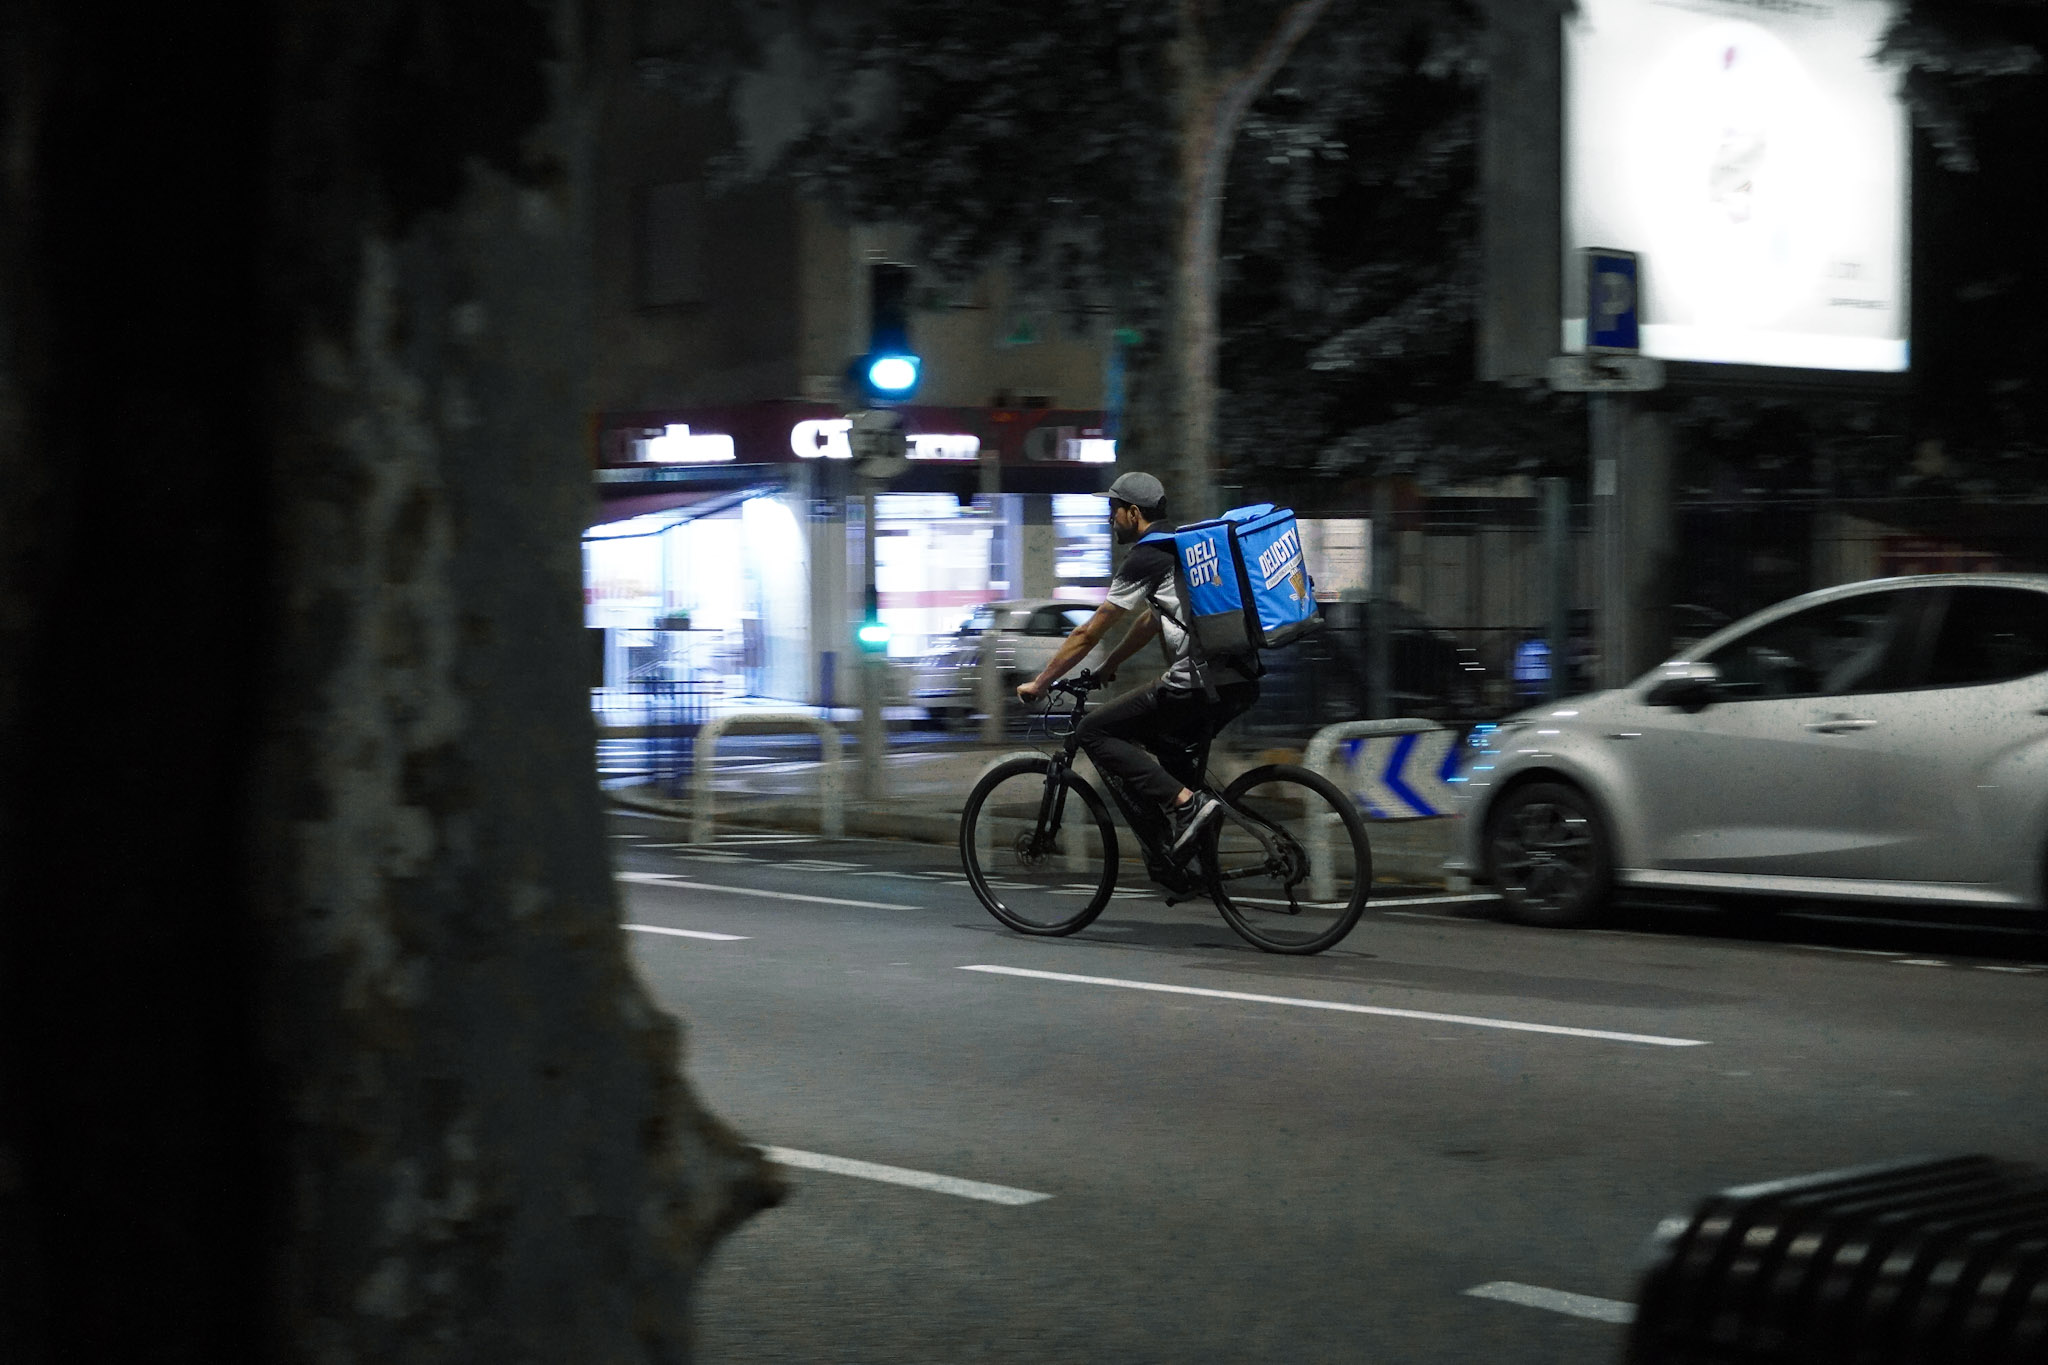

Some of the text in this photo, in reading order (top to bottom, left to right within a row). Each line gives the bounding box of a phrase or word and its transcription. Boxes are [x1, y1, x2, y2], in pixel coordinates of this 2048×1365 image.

[1594, 271, 1634, 332] P
[1185, 537, 1216, 568] DELI
[1190, 557, 1219, 588] CITY
[1258, 527, 1299, 579] DELICITY
